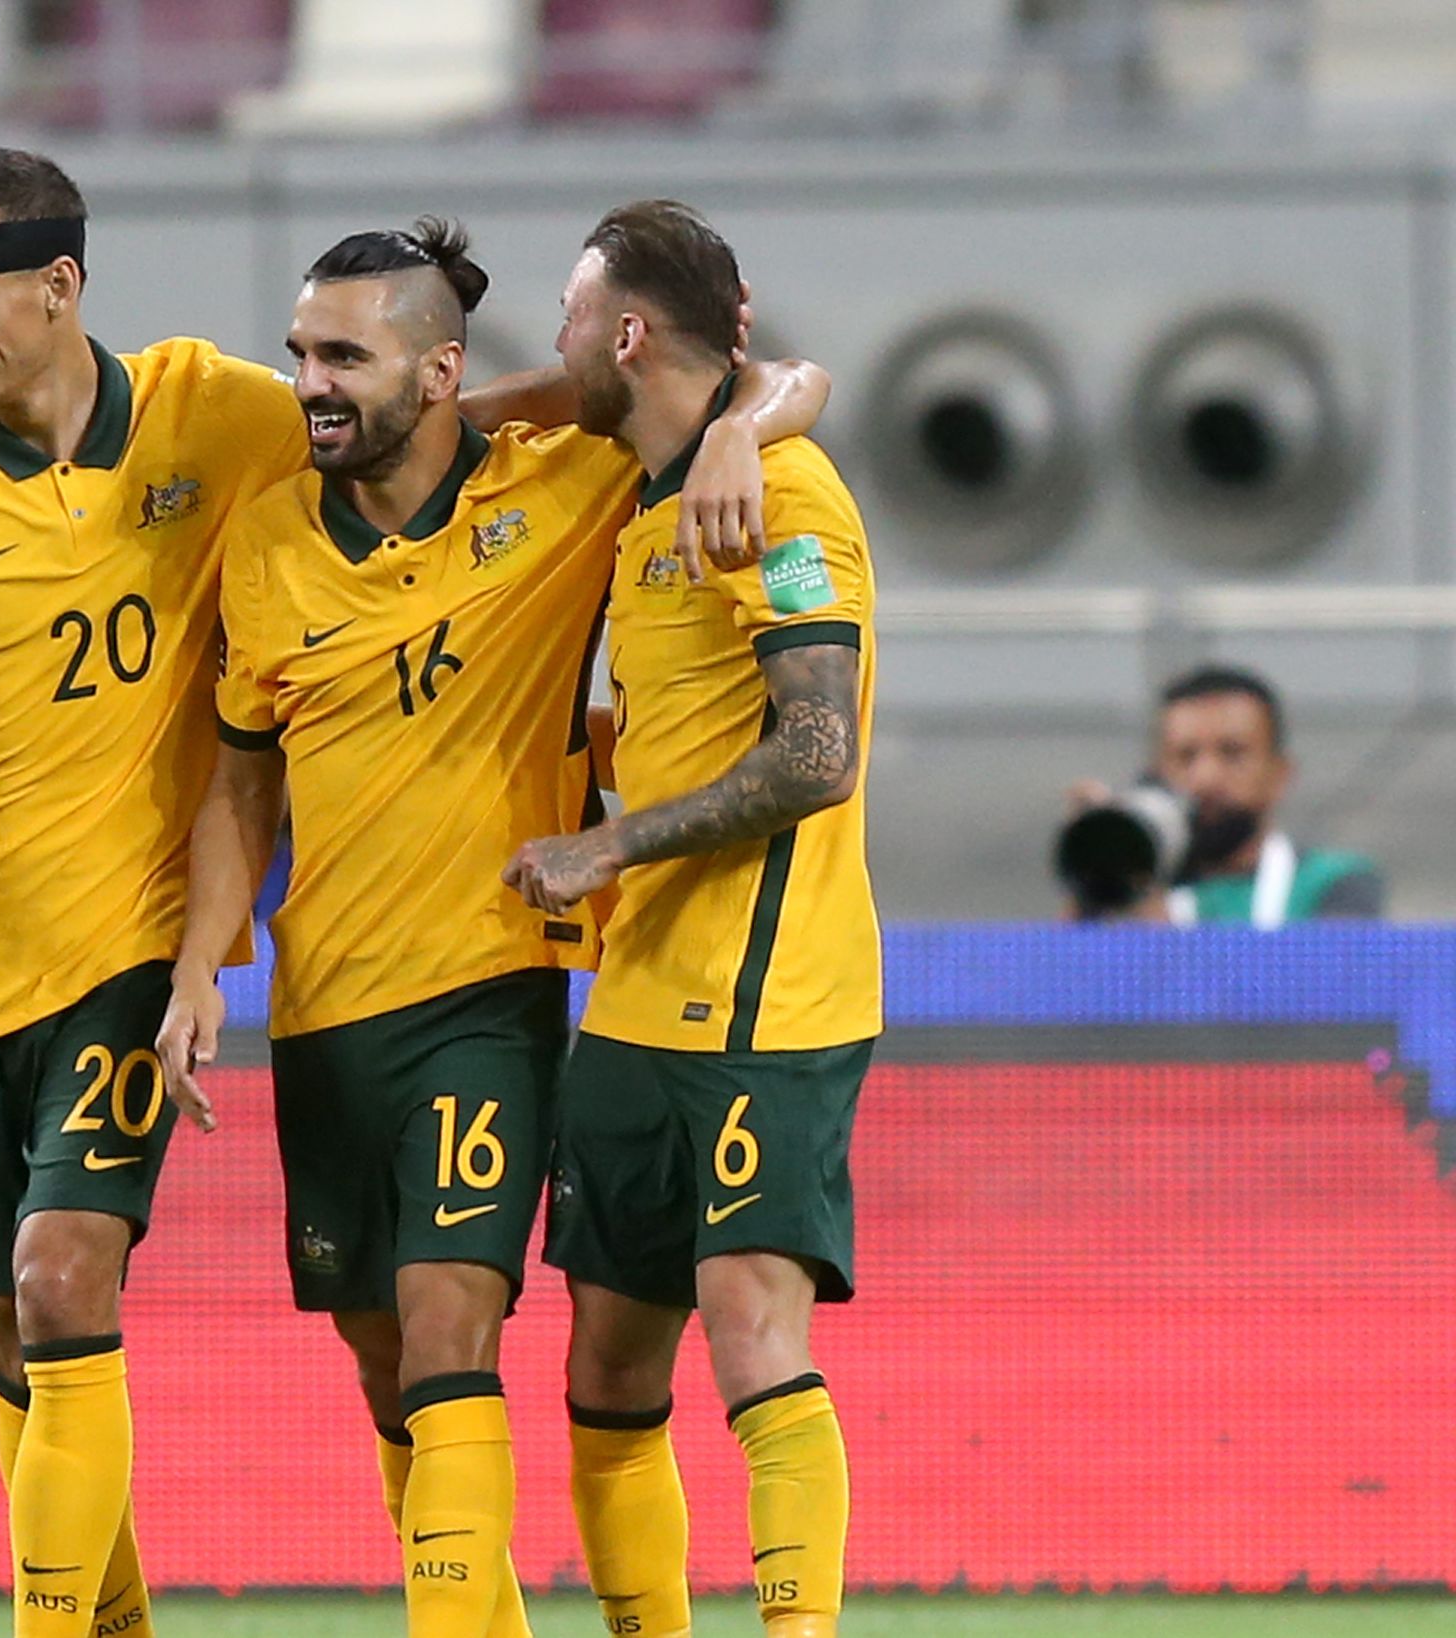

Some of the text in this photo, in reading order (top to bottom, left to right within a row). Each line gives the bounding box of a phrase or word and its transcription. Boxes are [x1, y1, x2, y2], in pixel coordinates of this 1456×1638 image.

[50, 593, 156, 703] 20
[394, 618, 464, 716] 16
[60, 1043, 164, 1137] 20
[431, 1095, 506, 1191] 16
[714, 1094, 761, 1188] 6
[24, 1590, 79, 1614] AUS
[412, 1560, 469, 1582] AUS
[96, 1606, 144, 1638] AUS
